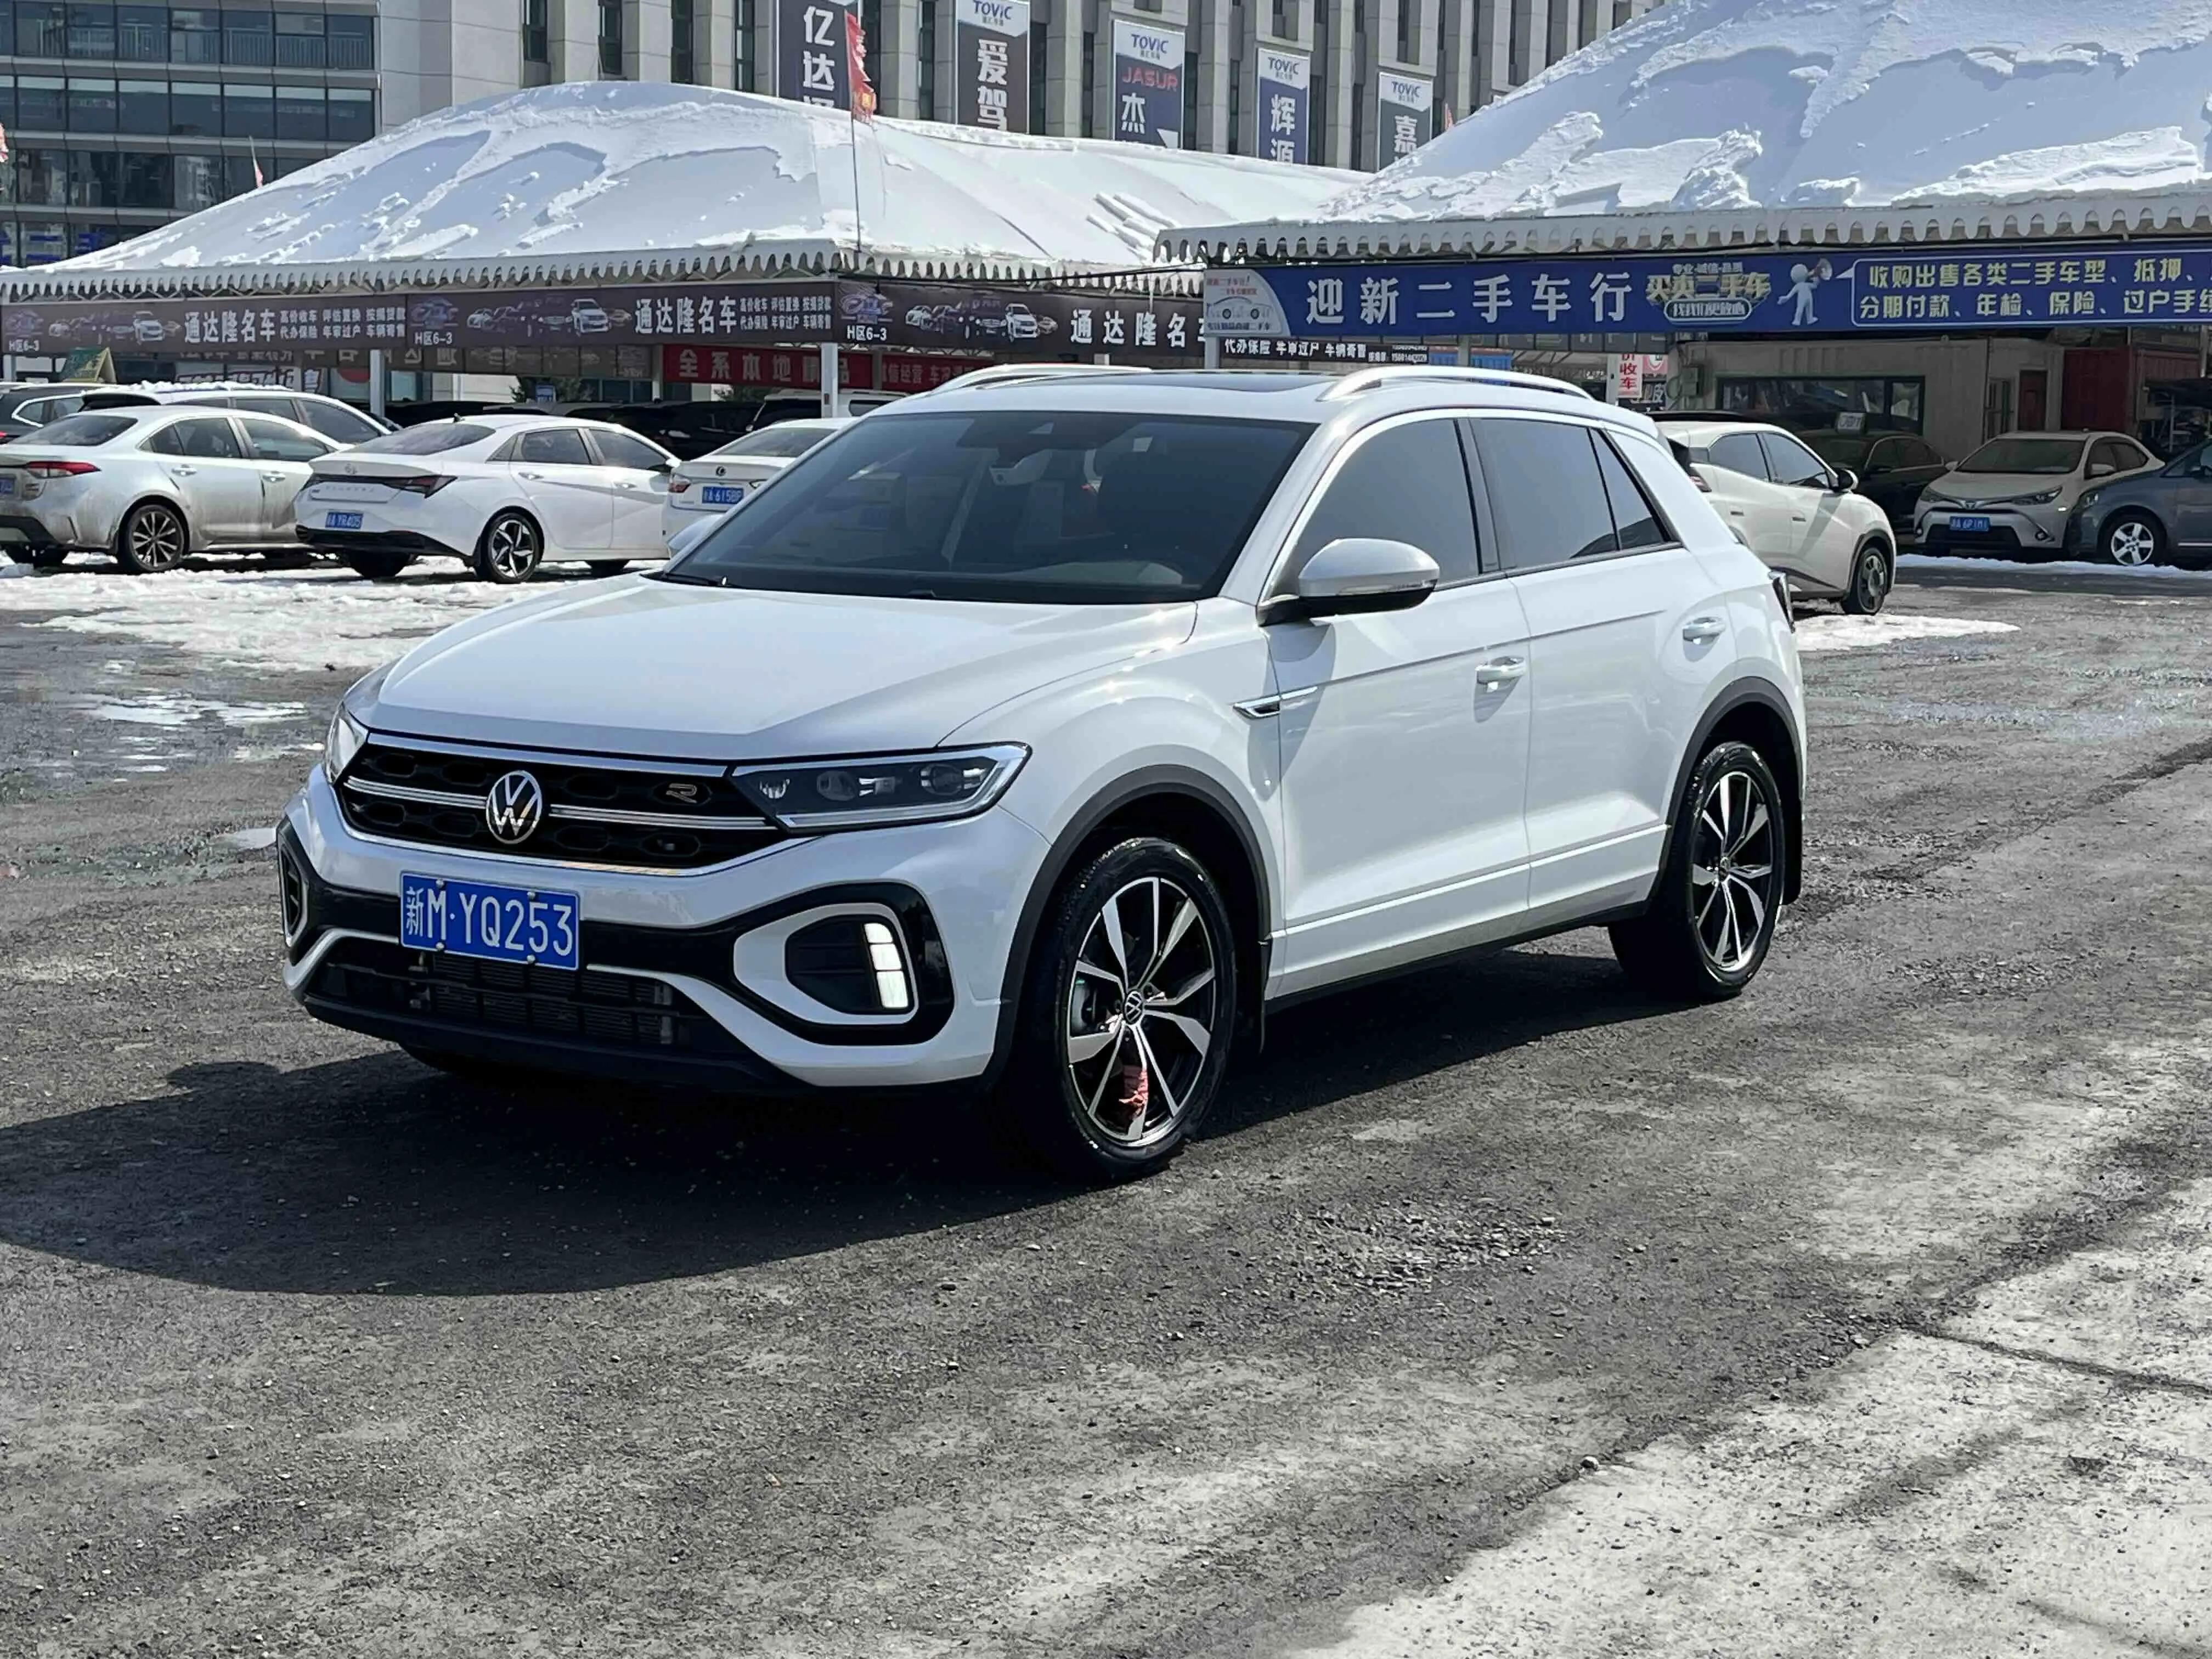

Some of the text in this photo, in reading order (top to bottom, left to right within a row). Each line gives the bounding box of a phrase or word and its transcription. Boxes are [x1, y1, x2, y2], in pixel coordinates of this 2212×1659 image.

[1121, 92, 1146, 143] 杰
[1394, 115, 1418, 161] 嘉
[635, 296, 737, 334] 通达隆名车
[1306, 272, 1632, 325] 迎新二手车行
[184, 308, 275, 343] 通达隆名车
[847, 325, 887, 341] H区6-3
